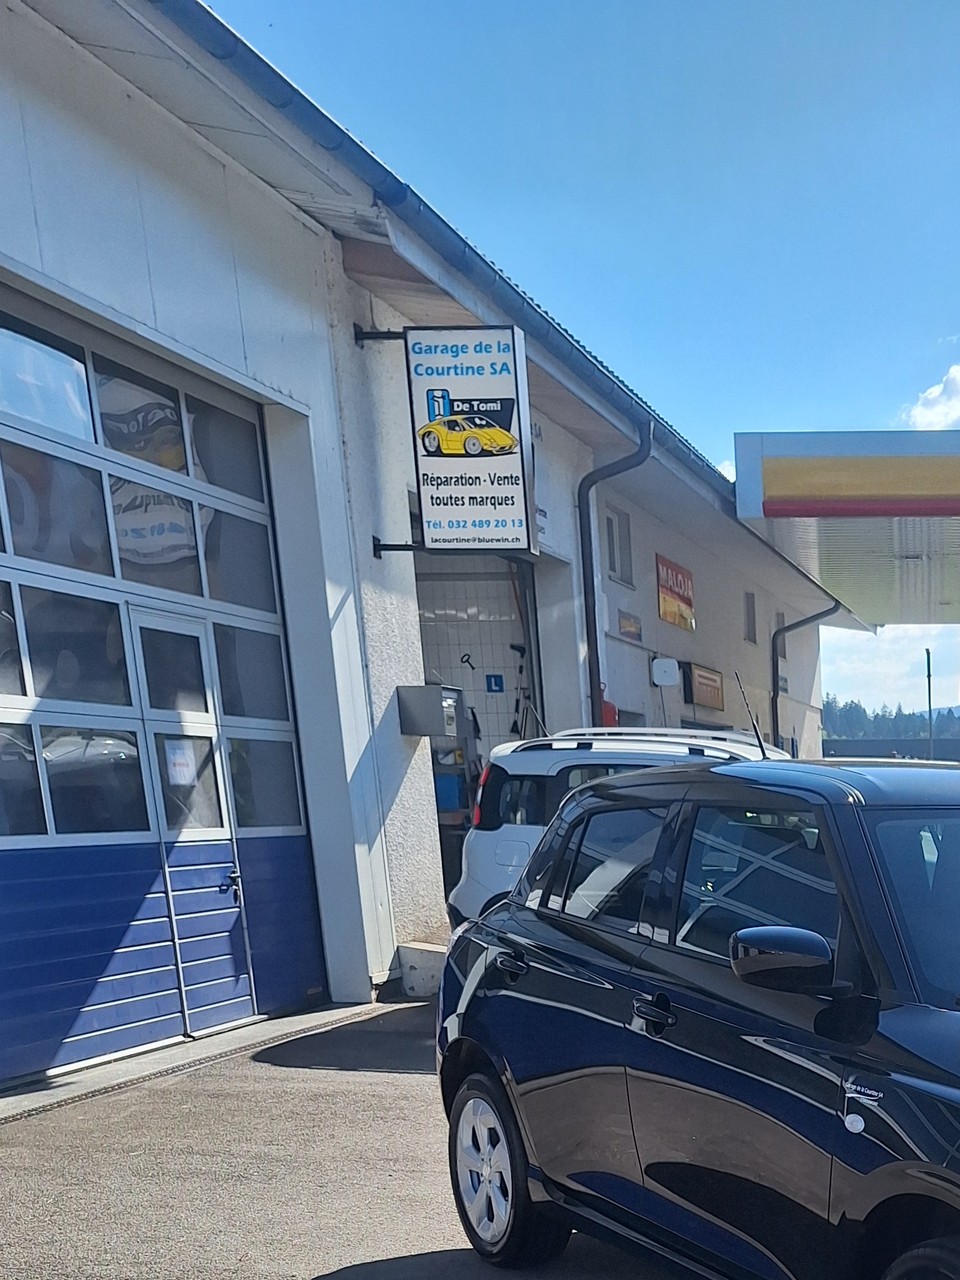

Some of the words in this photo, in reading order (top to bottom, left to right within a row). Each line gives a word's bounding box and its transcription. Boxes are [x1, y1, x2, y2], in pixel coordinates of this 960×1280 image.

[411, 341, 469, 358] Garage
[474, 341, 493, 354] de
[497, 340, 511, 353] la
[413, 362, 485, 376] Courtine
[489, 361, 512, 375] SA
[453, 401, 470, 411] De
[471, 400, 501, 411] Tomi
[422, 473, 481, 490] Réparation
[487, 472, 520, 486] Vente
[430, 494, 465, 506] toutes
[468, 495, 515, 510] marques
[425, 519, 445, 529] Tél.
[447, 520, 468, 529] 032
[471, 519, 491, 529] 489
[494, 519, 507, 528] 20
[511, 518, 523, 528] 13
[431, 536, 521, 544] lacourtine@bluewin.ch
[659, 563, 693, 599] MALOJA
[491, 677, 499, 690] L
